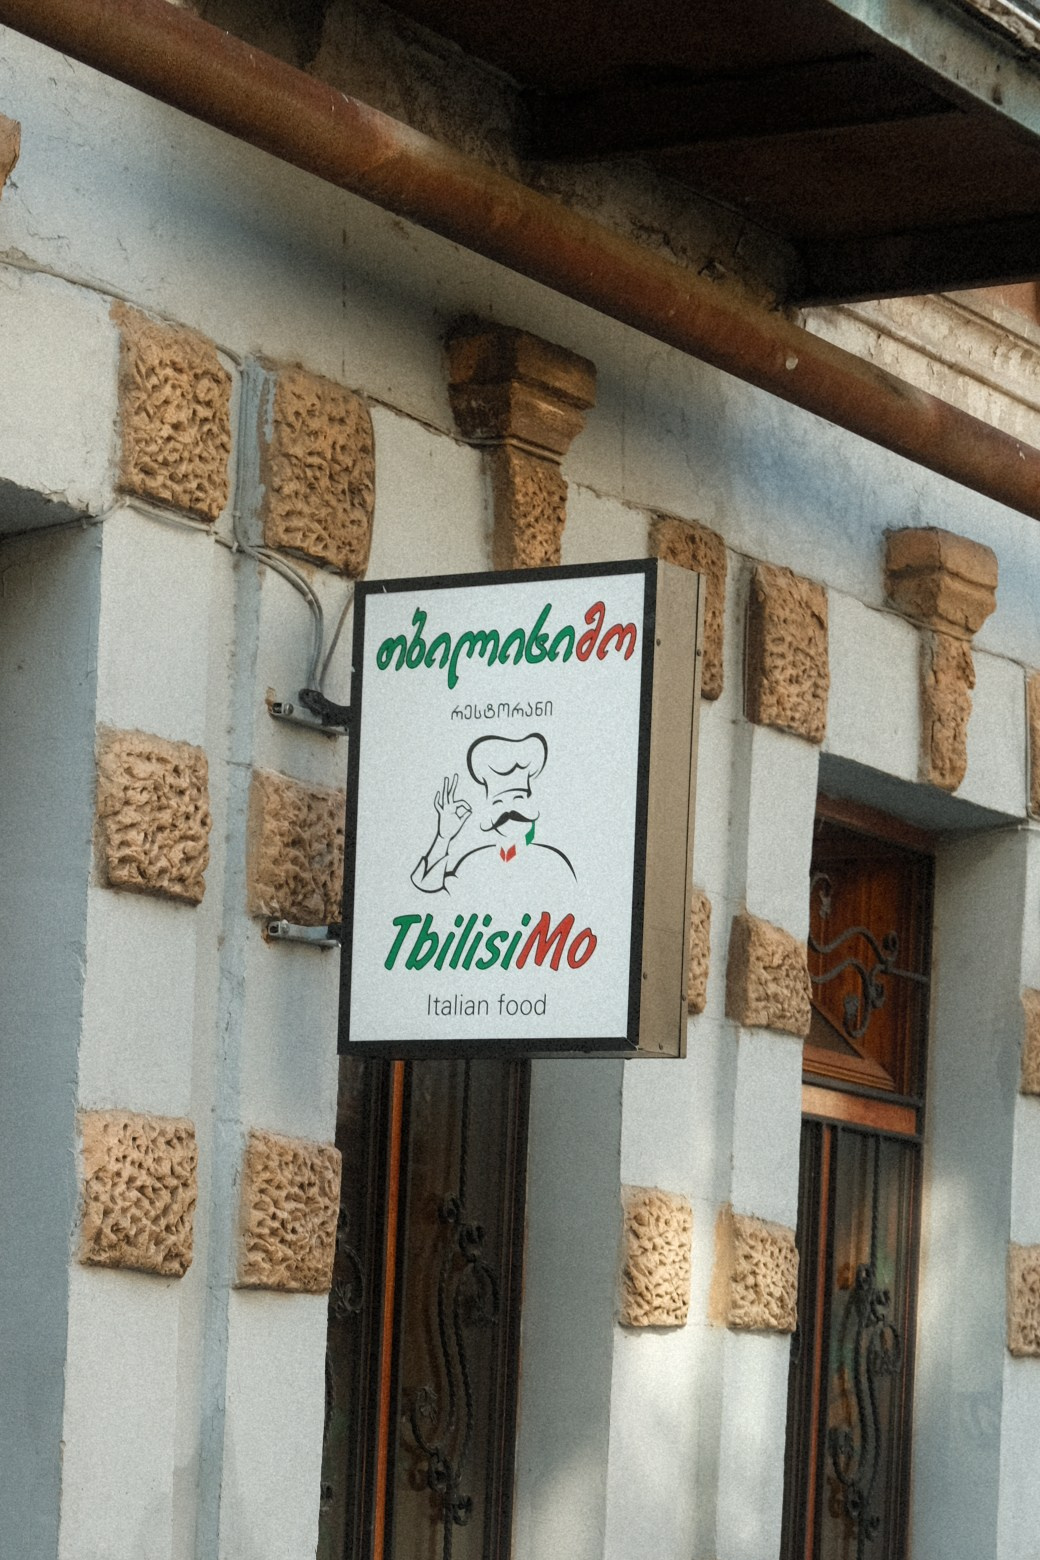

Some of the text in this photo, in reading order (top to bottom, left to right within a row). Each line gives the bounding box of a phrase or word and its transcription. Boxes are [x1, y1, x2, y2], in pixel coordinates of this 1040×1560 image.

[377, 602, 637, 689] თბილისიმო
[451, 701, 553, 720] რესტორანი
[385, 912, 598, 972] TbilisiMo
[427, 995, 548, 1017] Italian food
